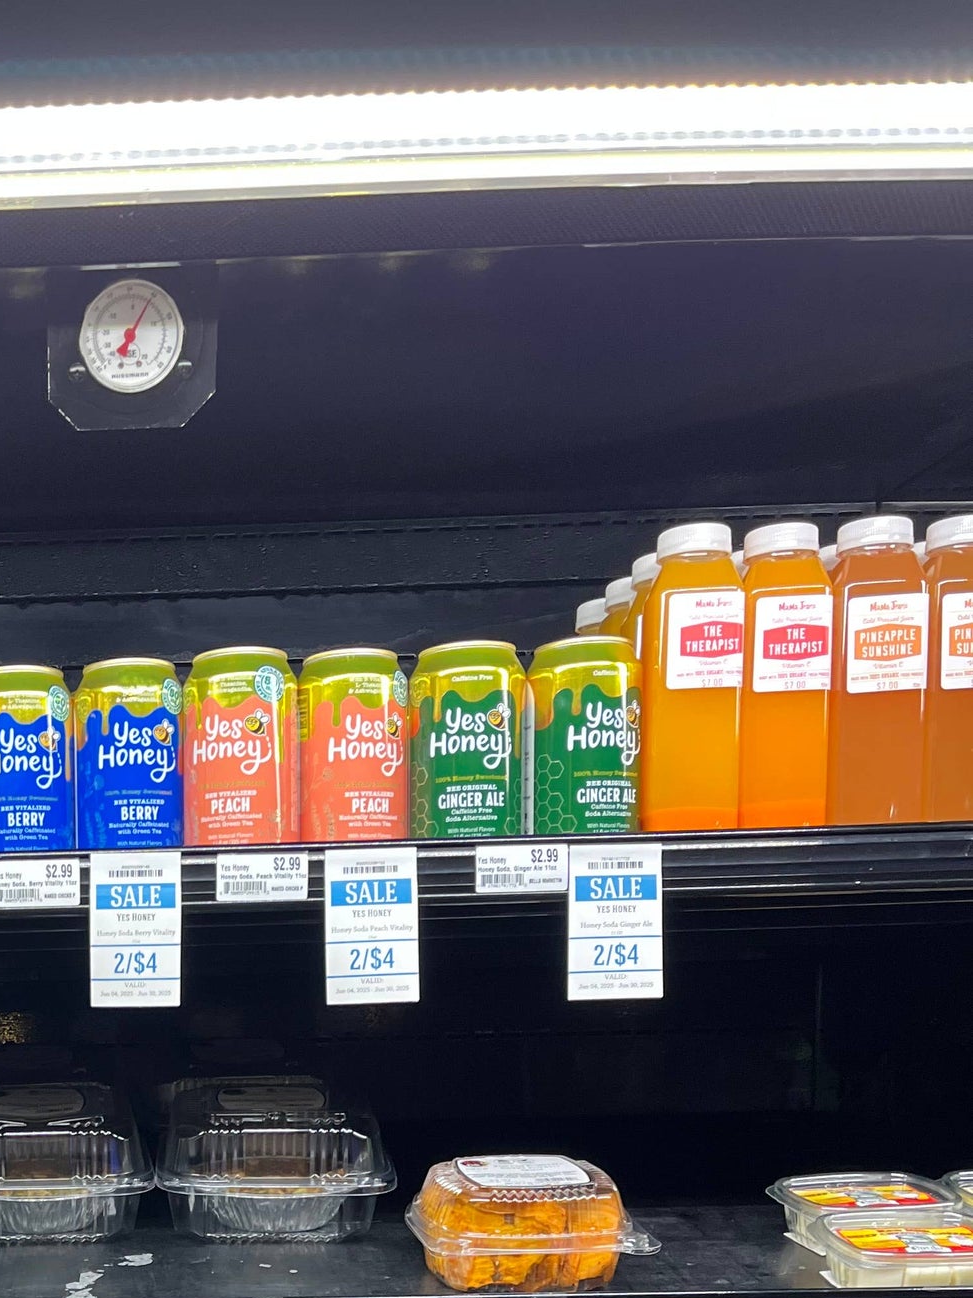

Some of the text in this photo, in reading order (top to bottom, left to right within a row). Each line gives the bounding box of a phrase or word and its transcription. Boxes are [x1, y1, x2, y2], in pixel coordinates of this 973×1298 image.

[703, 625, 722, 637] THE
[787, 628, 806, 640] THE
[859, 629, 915, 642] PINEAPPLE
[686, 638, 739, 653] THERAPIST
[768, 641, 823, 655] THERAPIST
[862, 643, 913, 657] SUNSHINE
[446, 707, 485, 733] Yes
[586, 701, 624, 728] Yes
[114, 721, 151, 746] Yes
[205, 715, 242, 740] Yes
[345, 714, 383, 740] Yes
[0, 728, 37, 754] Yes
[567, 726, 640, 766] Honey
[193, 739, 273, 775] Honey
[328, 739, 403, 776] Honey
[430, 733, 512, 769] Honey
[99, 745, 175, 783] Honey
[464, 784, 497, 792] ORIGINAL
[577, 787, 636, 804] GINGER ALE
[211, 797, 250, 813] PEACH
[351, 797, 389, 813] PEACH
[438, 792, 505, 809] GINGER ALE
[7, 812, 45, 827] BERRY
[121, 806, 159, 821] BERRY
[221, 857, 301, 873] Yes Honey $2.99
[490, 856, 507, 866] Honey
[531, 848, 559, 863] $2.99
[6, 872, 22, 881] Honey
[45, 864, 73, 879] $2.99
[345, 881, 398, 904] SALE
[589, 877, 643, 899] SALE
[110, 886, 162, 908] SALE
[352, 909, 392, 918] YES HONEY
[596, 904, 637, 913] YES HONEY
[117, 913, 156, 922] YES HONEY
[114, 951, 157, 975] 2/$4
[350, 947, 395, 971] 2/$4
[594, 943, 639, 966] 2/$4
